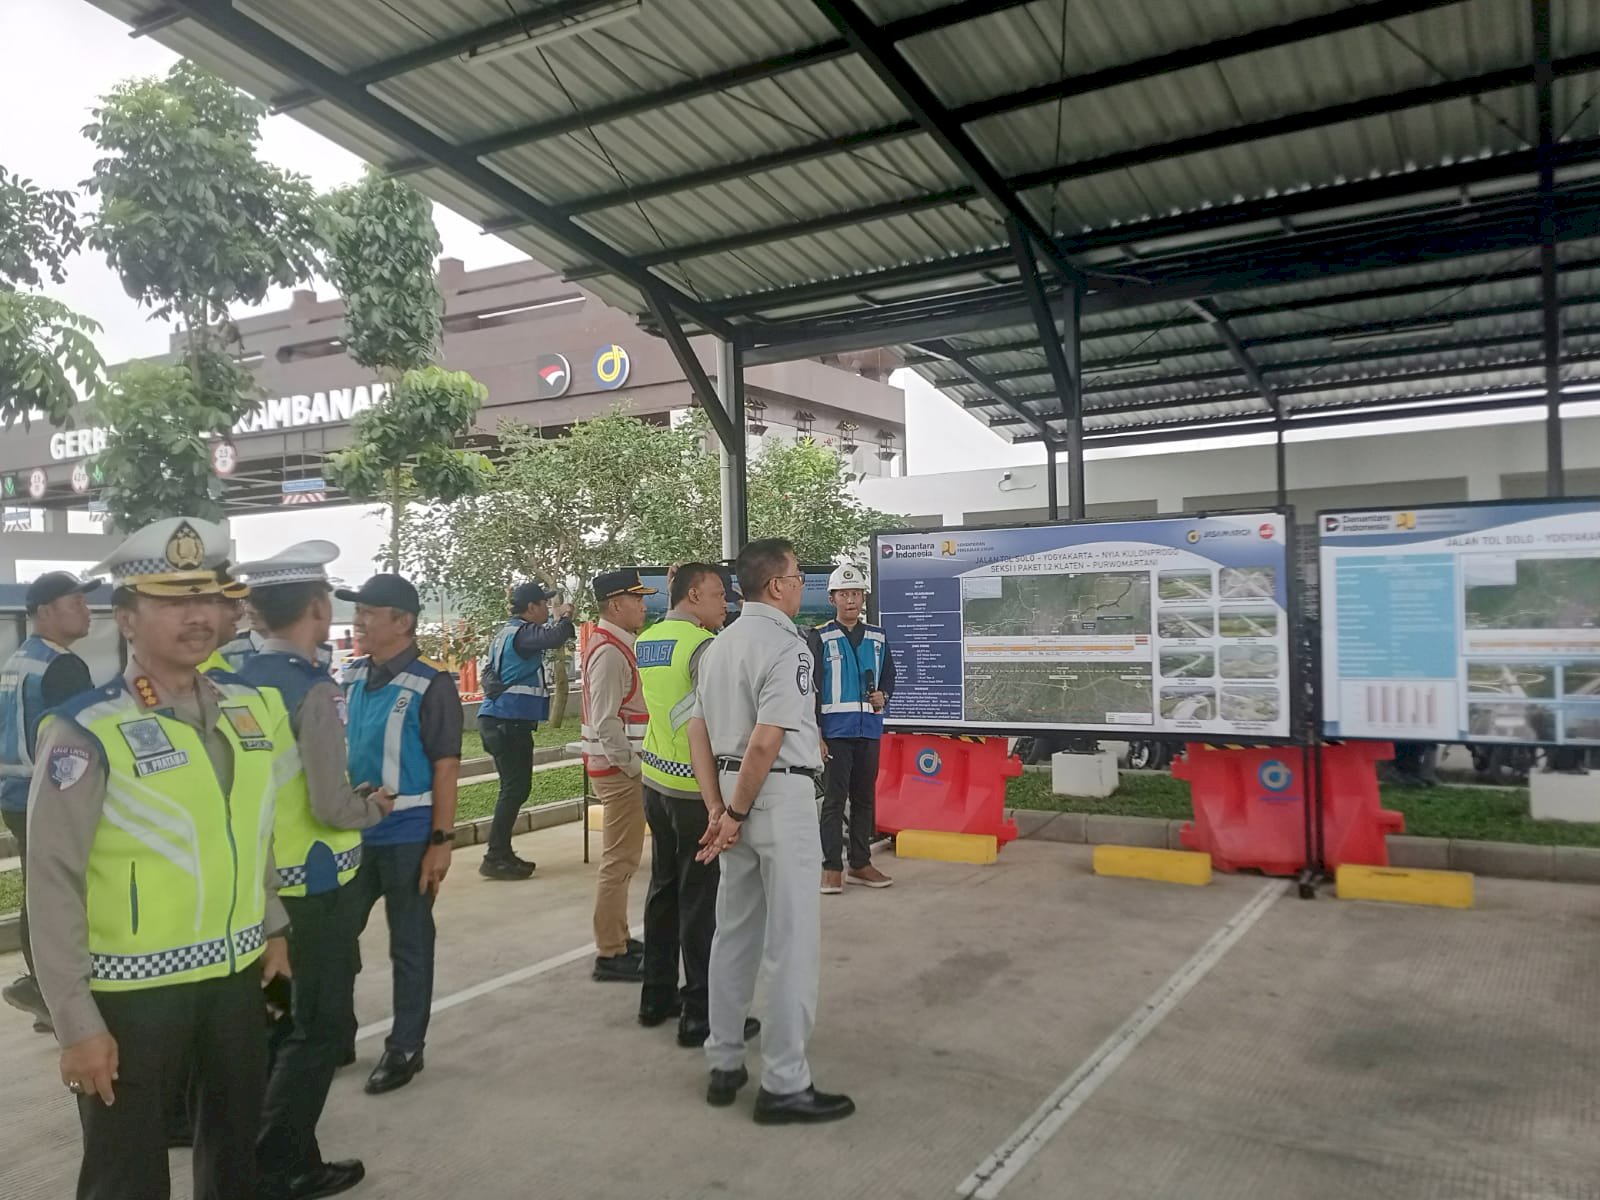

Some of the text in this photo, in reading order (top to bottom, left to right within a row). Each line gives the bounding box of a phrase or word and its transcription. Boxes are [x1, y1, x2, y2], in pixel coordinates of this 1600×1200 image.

[1505, 534, 1534, 545] SOLO
[895, 543, 935, 551] Danantara
[895, 550, 933, 559] Indonesia
[975, 556, 998, 565] JALAN
[1015, 554, 1035, 562] SOLO
[1044, 551, 1093, 561] YOGYAKARTA
[990, 564, 1012, 573] SEKSI
[1017, 563, 1041, 572] PAKET
[1054, 562, 1084, 570] KLATEN
[1092, 559, 1158, 569] PURWOMARTANI
[637, 645, 672, 663] POLISI
[151, 753, 187, 772] PRATAMA
